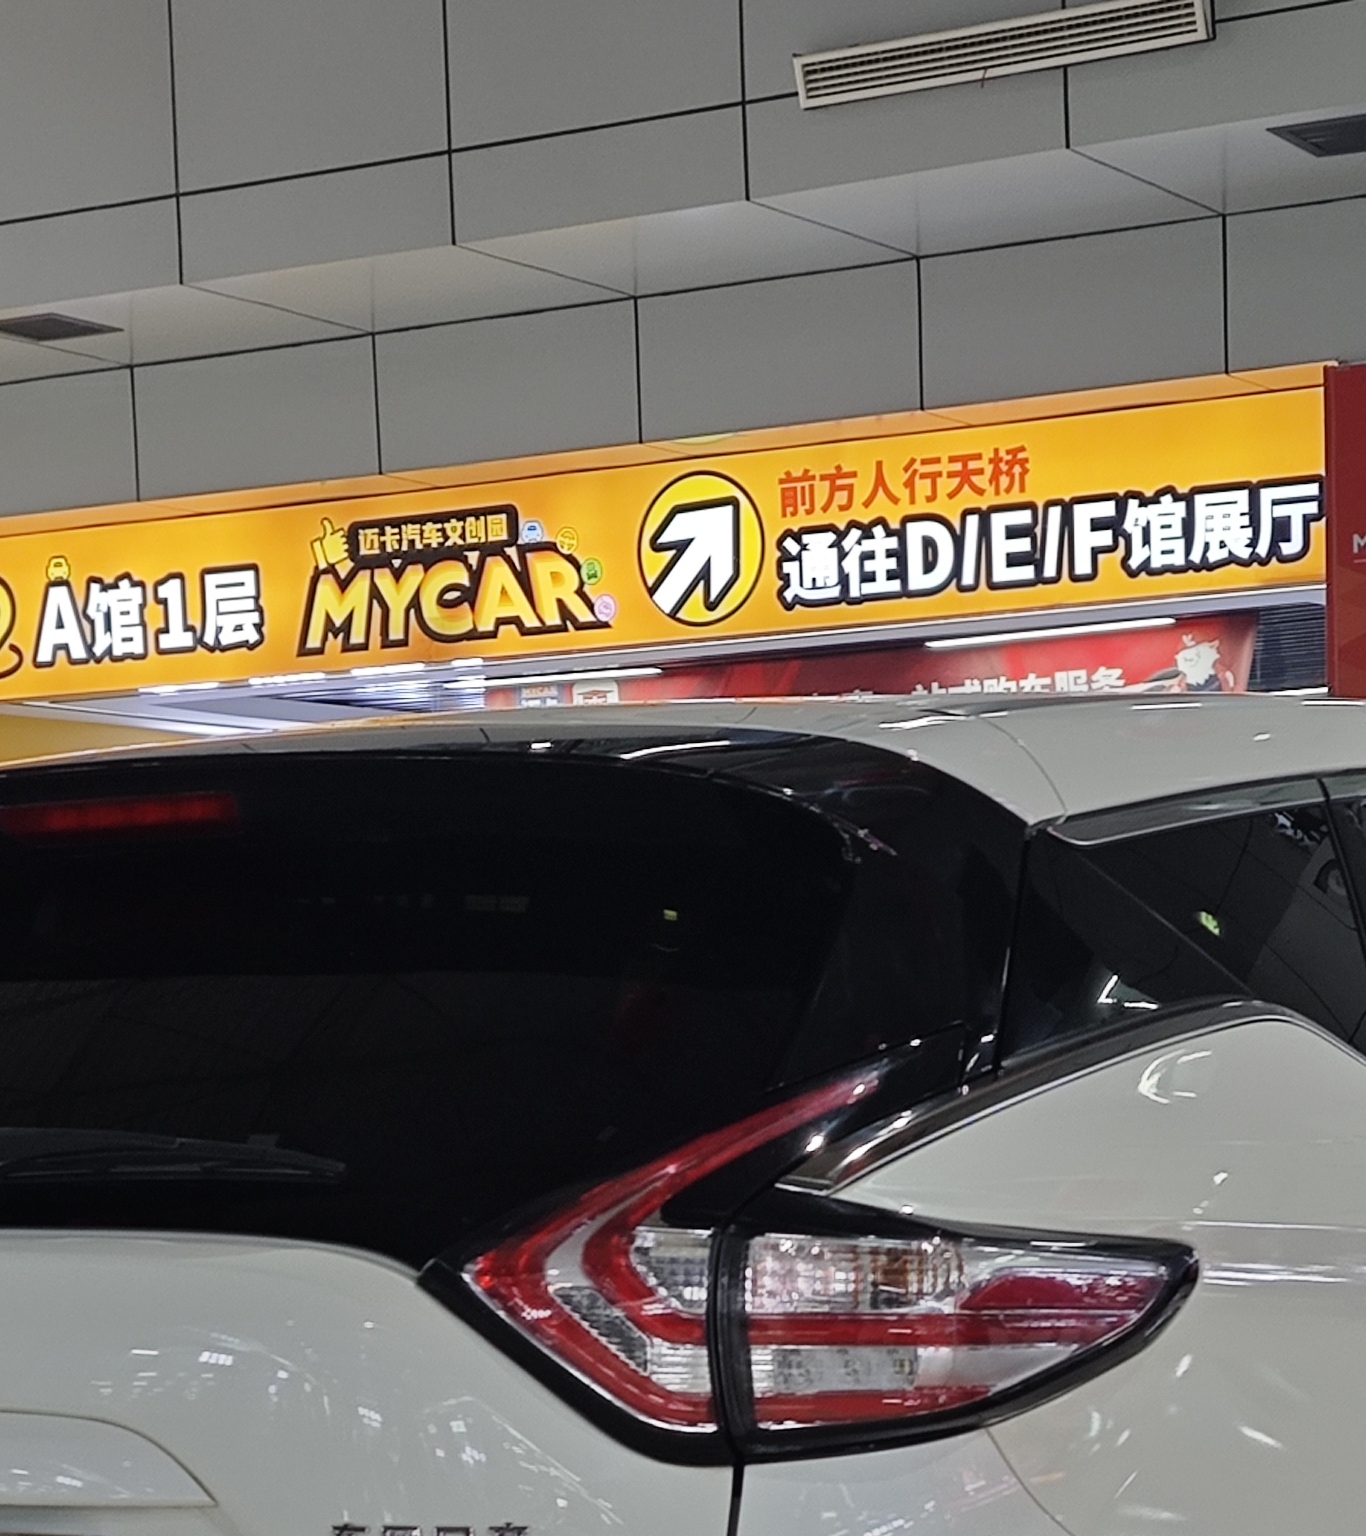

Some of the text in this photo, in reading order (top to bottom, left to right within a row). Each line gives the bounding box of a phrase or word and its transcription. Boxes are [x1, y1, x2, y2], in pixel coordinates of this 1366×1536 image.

[356, 512, 509, 554] 迈卡汽车文创园
[777, 445, 1030, 518] 前方人行天桥
[778, 481, 1322, 606] 通往D/E/F馆展厅
[34, 564, 265, 668] A馆1层
[300, 549, 603, 654] MYCAR
